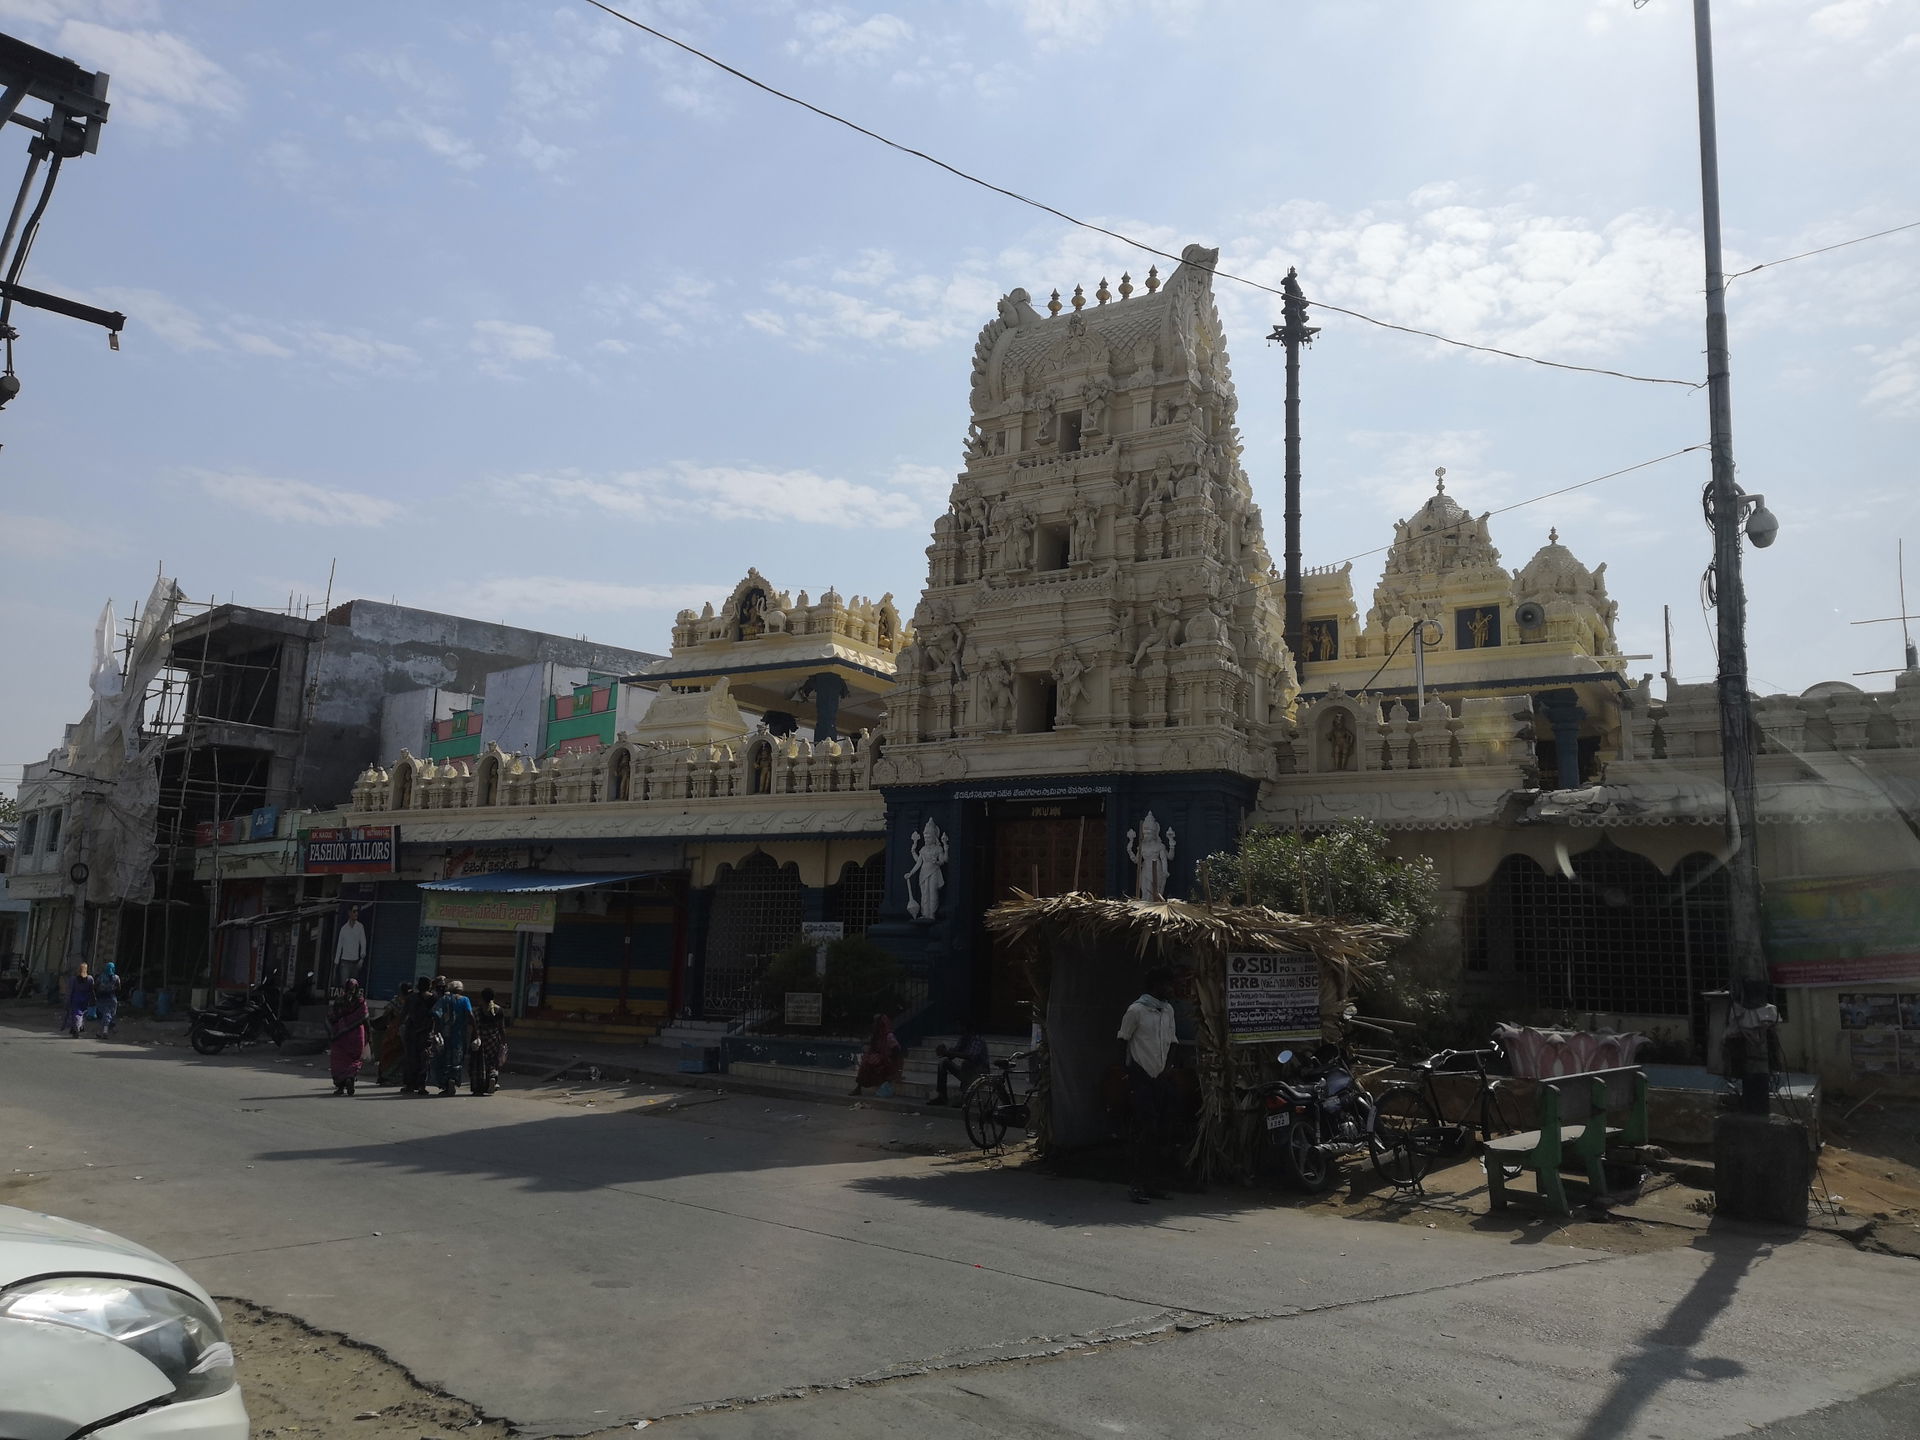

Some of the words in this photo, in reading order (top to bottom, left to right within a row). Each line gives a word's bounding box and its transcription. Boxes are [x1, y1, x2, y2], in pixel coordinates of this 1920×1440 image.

[309, 842, 348, 862] FASHION
[350, 841, 390, 861] TAILORS
[1247, 957, 1277, 973] SBI
[1230, 976, 1260, 989] RRB
[1298, 976, 1318, 988] SSC
